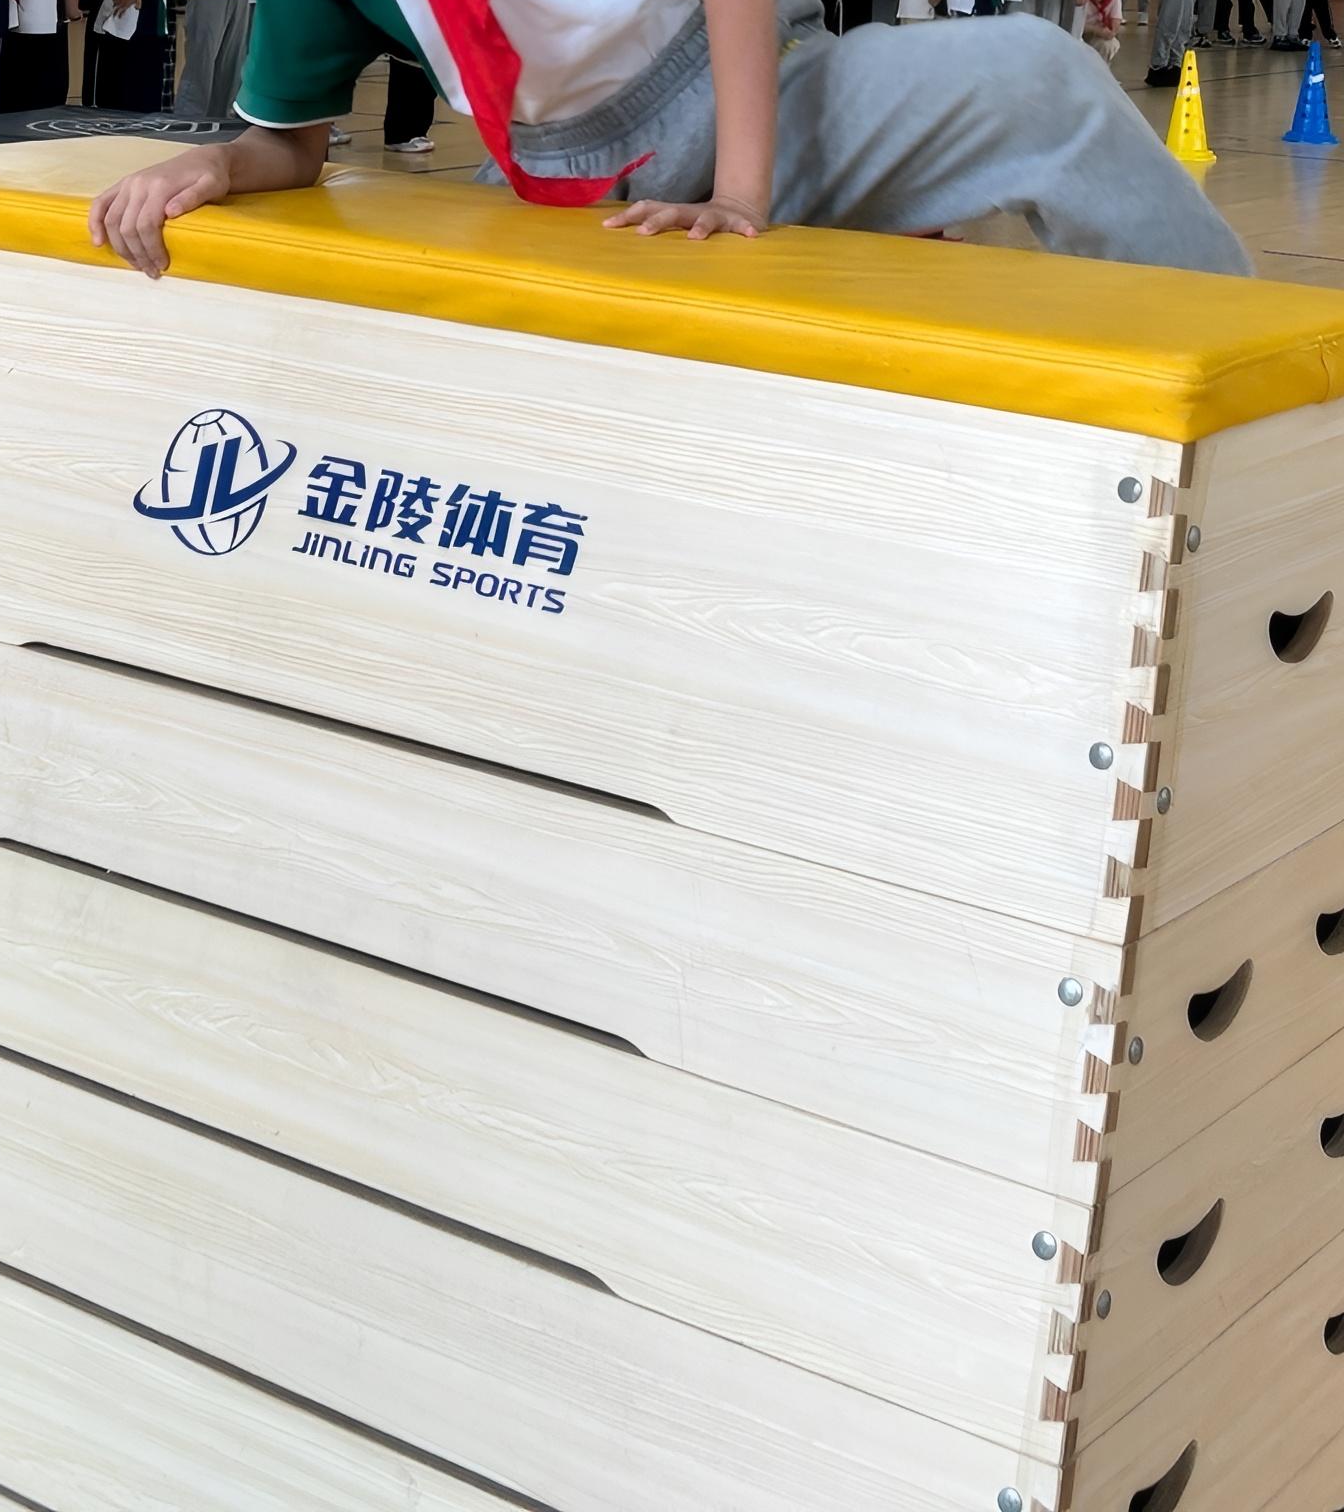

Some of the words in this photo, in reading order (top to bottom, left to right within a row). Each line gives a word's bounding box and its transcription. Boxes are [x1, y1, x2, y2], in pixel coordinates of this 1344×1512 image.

[297, 454, 589, 576] 金陵体育
[429, 562, 566, 614] SPORTS
